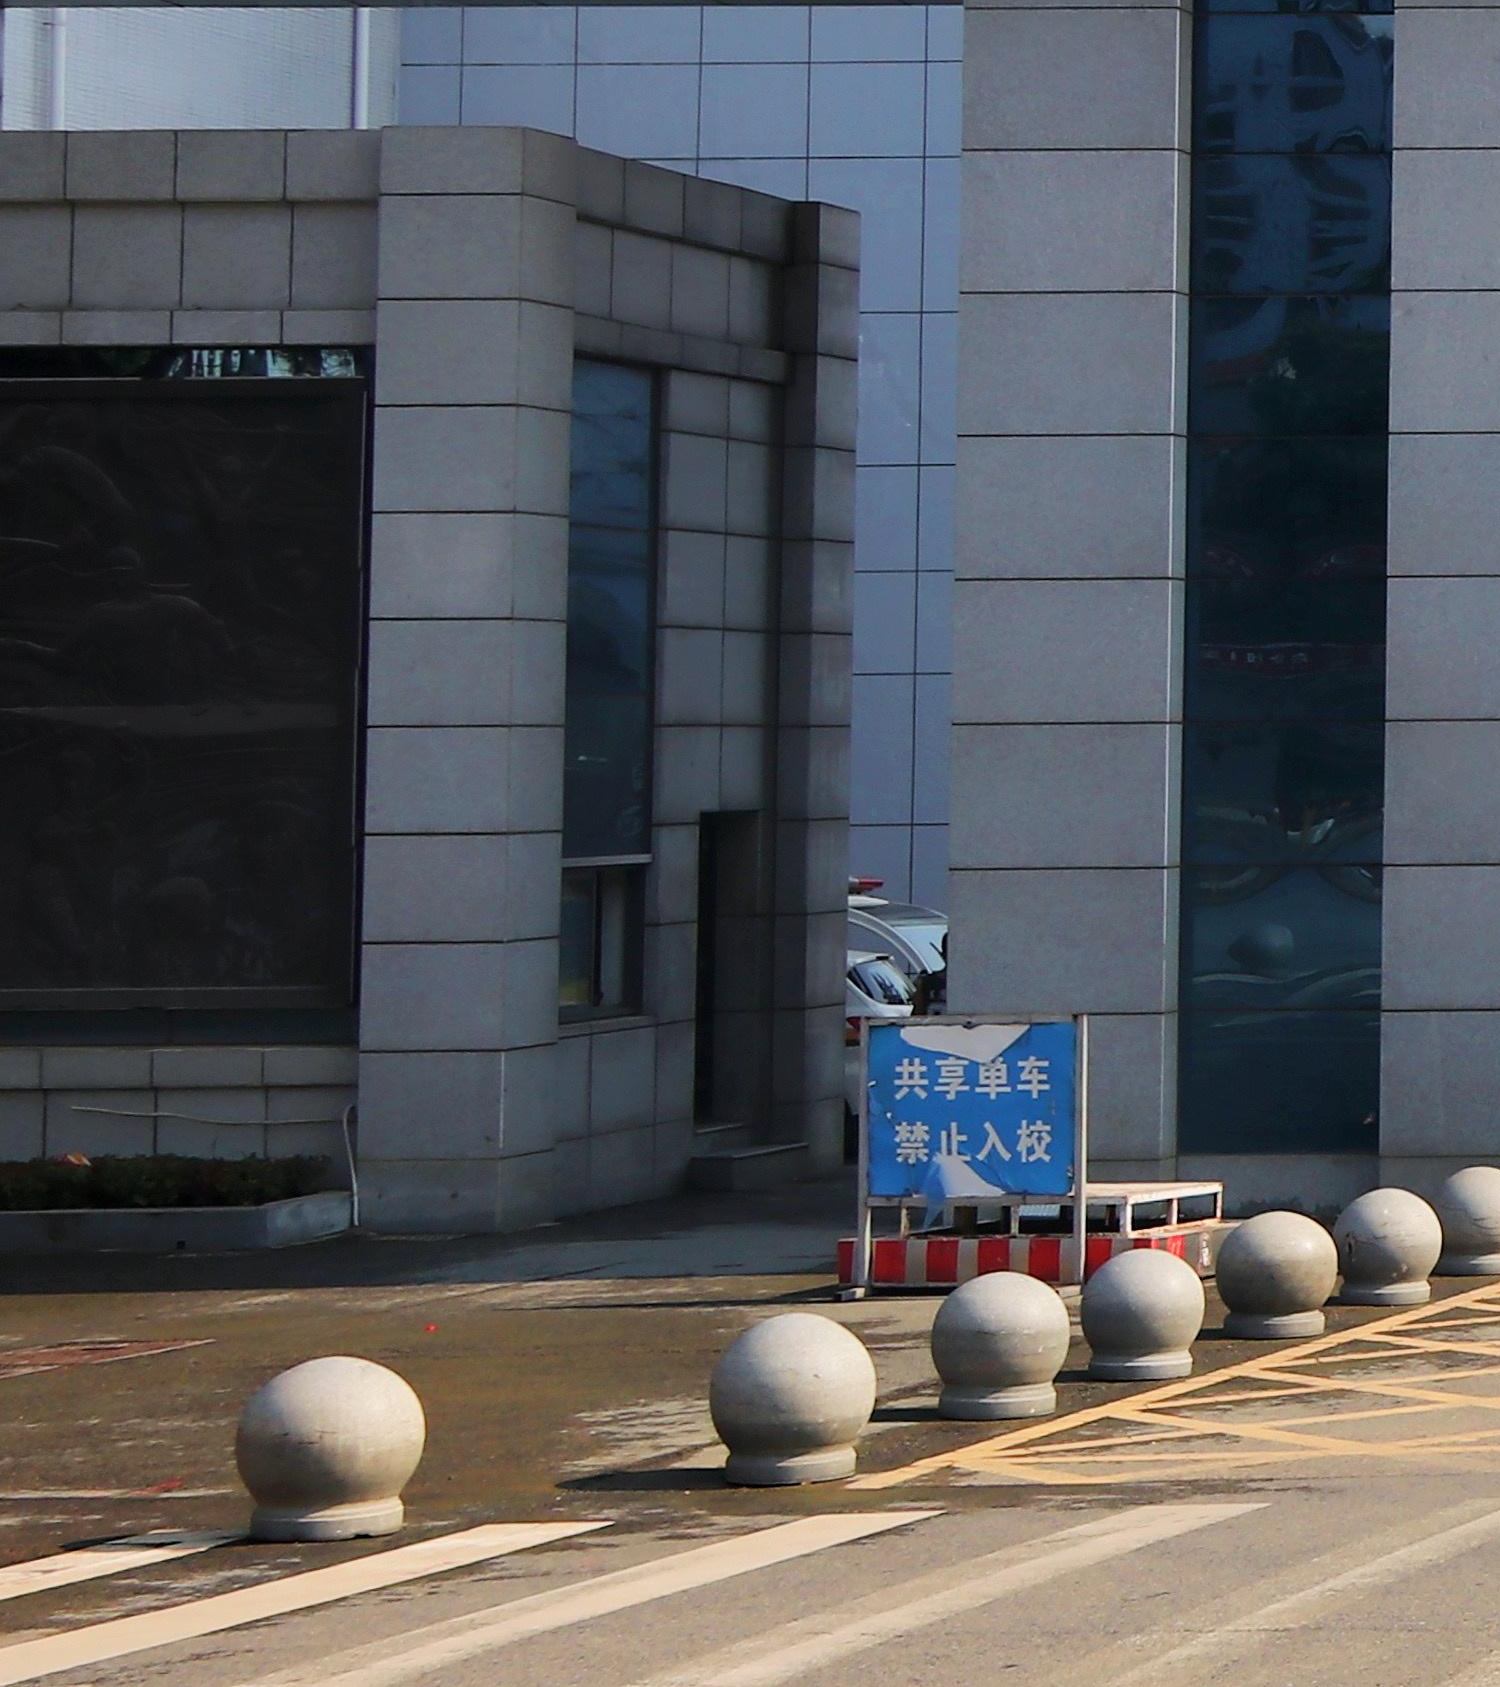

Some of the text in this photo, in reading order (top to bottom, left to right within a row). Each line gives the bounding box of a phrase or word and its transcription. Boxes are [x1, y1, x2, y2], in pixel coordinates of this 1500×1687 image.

[893, 1055, 1051, 1101] 共享单车
[893, 1119, 1053, 1164] 禁止入校
